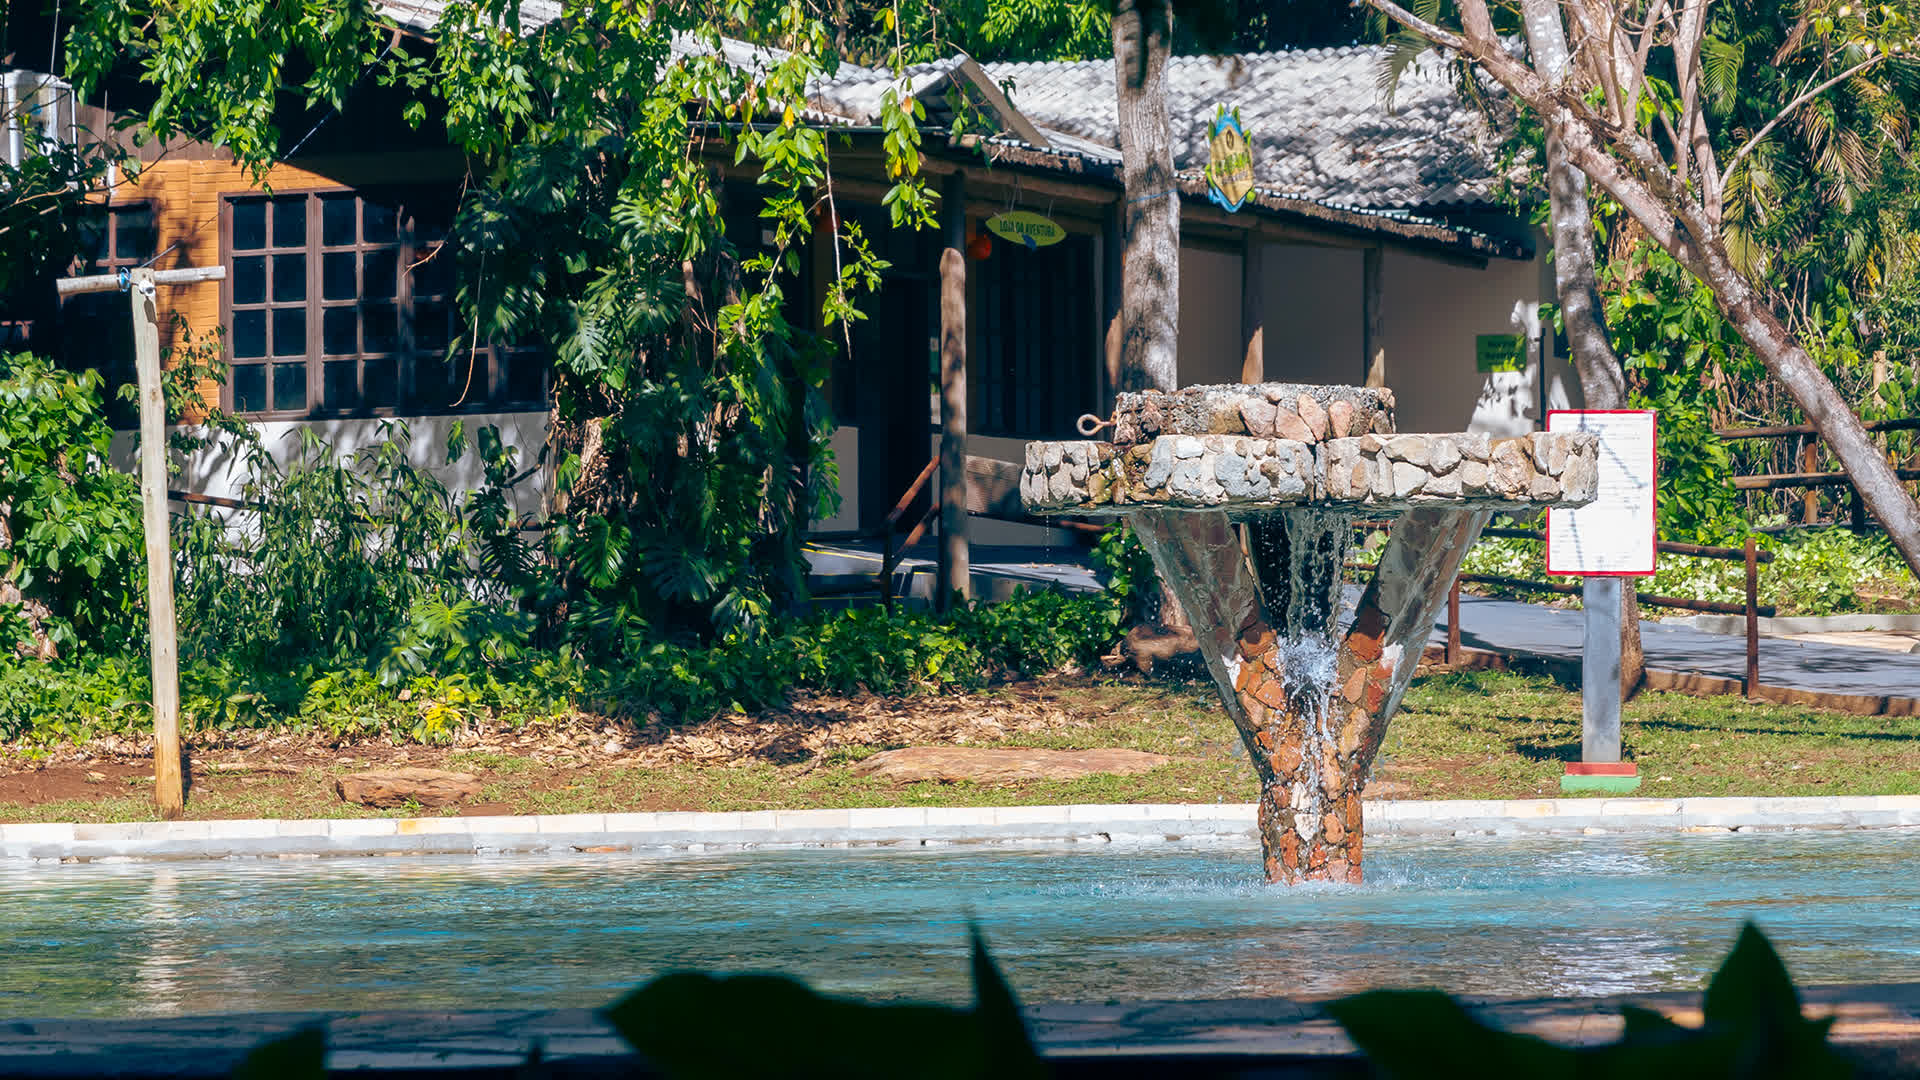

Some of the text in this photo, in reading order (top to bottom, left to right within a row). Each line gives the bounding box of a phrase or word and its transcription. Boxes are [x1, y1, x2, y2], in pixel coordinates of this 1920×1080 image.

[999, 220, 1056, 237] LOJA DA AVENTURA
